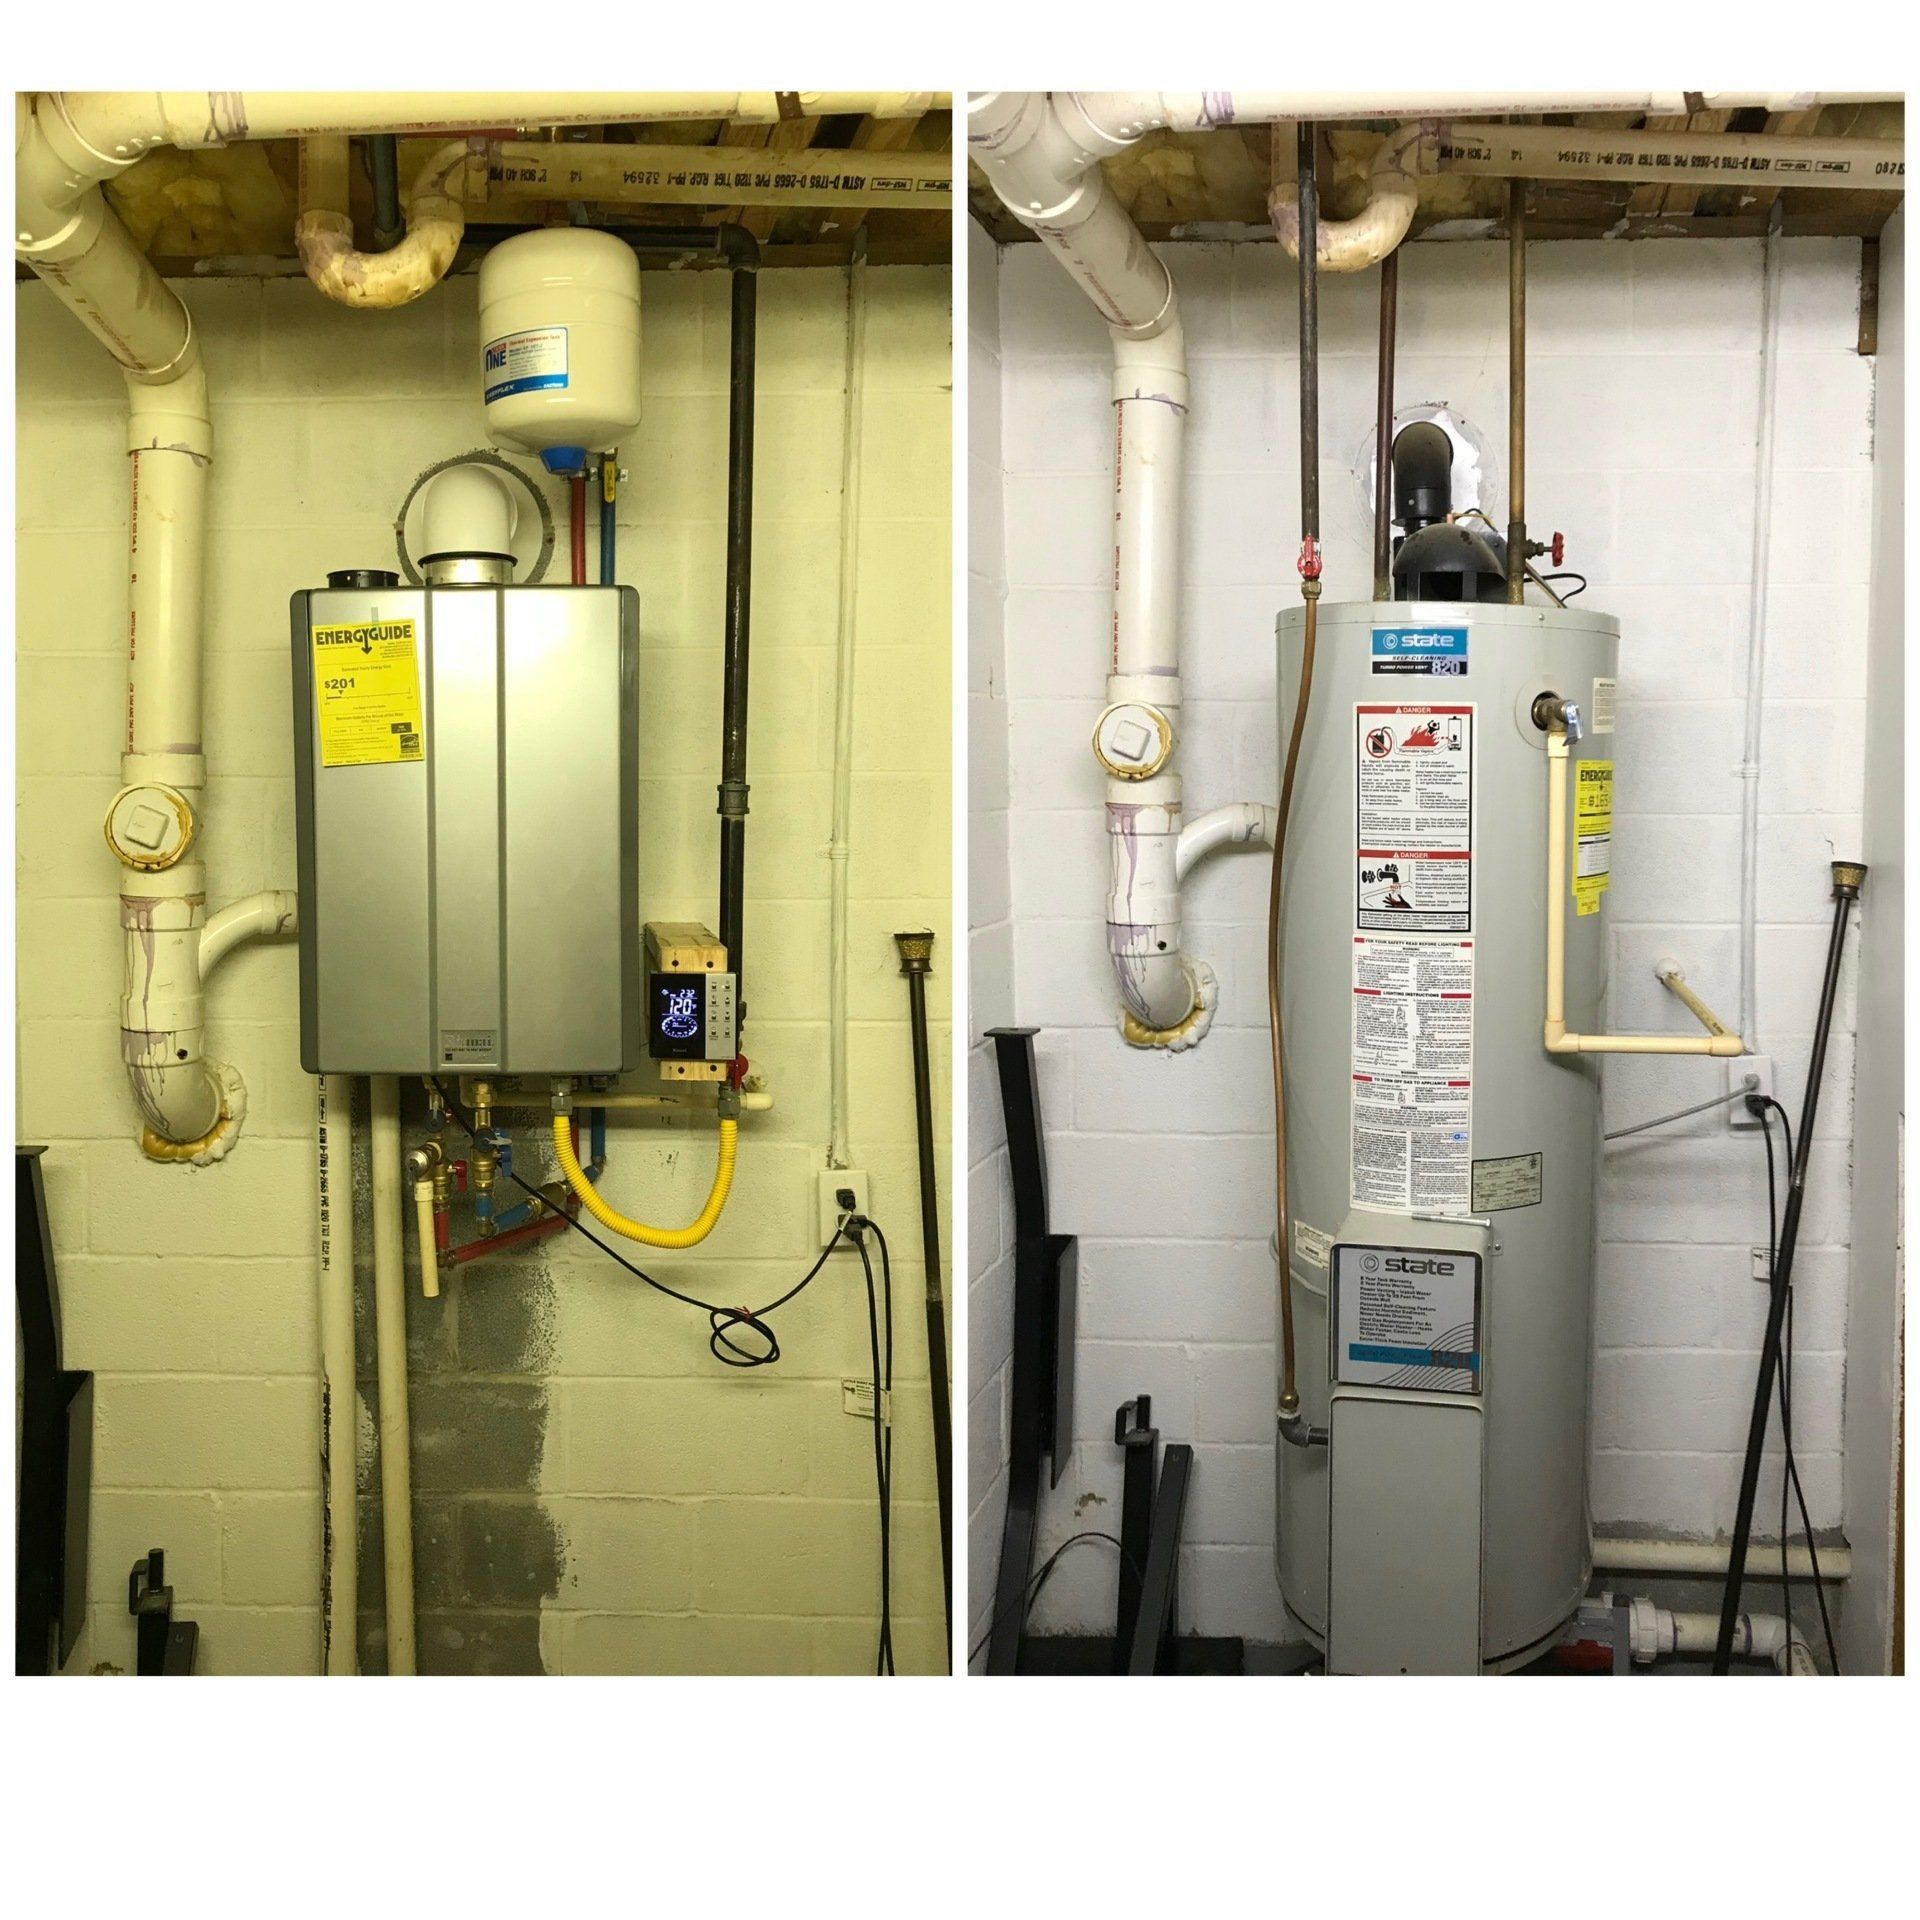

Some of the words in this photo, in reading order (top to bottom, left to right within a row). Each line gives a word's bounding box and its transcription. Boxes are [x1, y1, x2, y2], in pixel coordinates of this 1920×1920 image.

[1454, 147, 1466, 160] 40
[1467, 148, 1482, 160] SCH
[1512, 150, 1522, 161] 14
[1558, 150, 1591, 163] 32594
[1674, 155, 1688, 168] PVC
[1722, 156, 1748, 170] D-1785
[1751, 158, 1771, 171] ASTM
[506, 168, 518, 181] 40
[520, 169, 536, 182] SCH
[570, 170, 582, 182] 14
[623, 170, 660, 184] 32594
[667, 172, 686, 186] PP-1
[735, 173, 752, 187] 1120
[755, 174, 771, 188] PVC
[774, 174, 807, 188] D-2665
[810, 174, 840, 189] D-1785
[842, 176, 866, 190] ASTM
[316, 624, 412, 651] ENERGYGUIDE
[1401, 634, 1454, 647] state
[1431, 660, 1461, 676] 820
[324, 678, 355, 690] $201
[680, 988, 695, 998] 232
[670, 998, 692, 1014] 120
[321, 1196, 329, 1207] PVC
[1385, 1257, 1455, 1276] state
